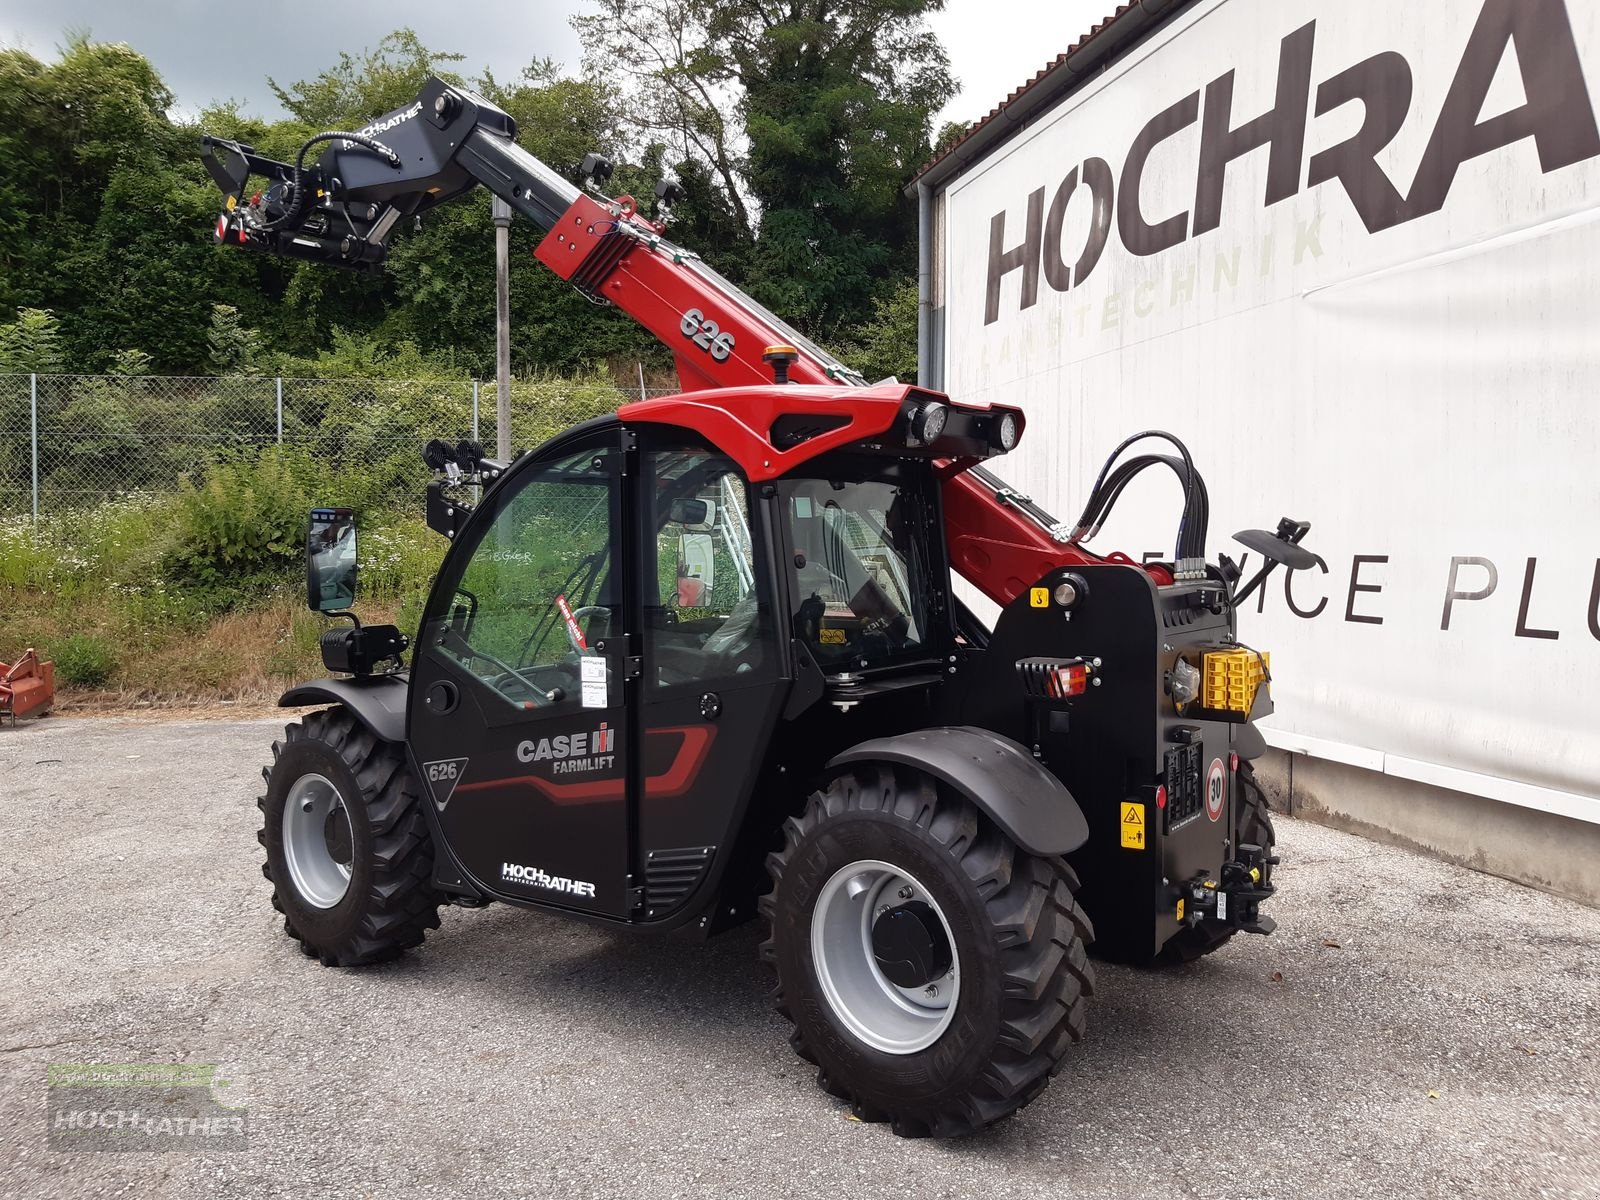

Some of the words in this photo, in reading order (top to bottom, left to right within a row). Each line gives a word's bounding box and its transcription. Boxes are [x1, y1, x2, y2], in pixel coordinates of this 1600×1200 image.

[680, 308, 735, 361] 626
[516, 732, 588, 763] CASE
[429, 762, 458, 782] 626
[553, 755, 615, 774] FARMLIFT
[1211, 776, 1221, 802] 30
[502, 862, 596, 897] HOCHRATHER
